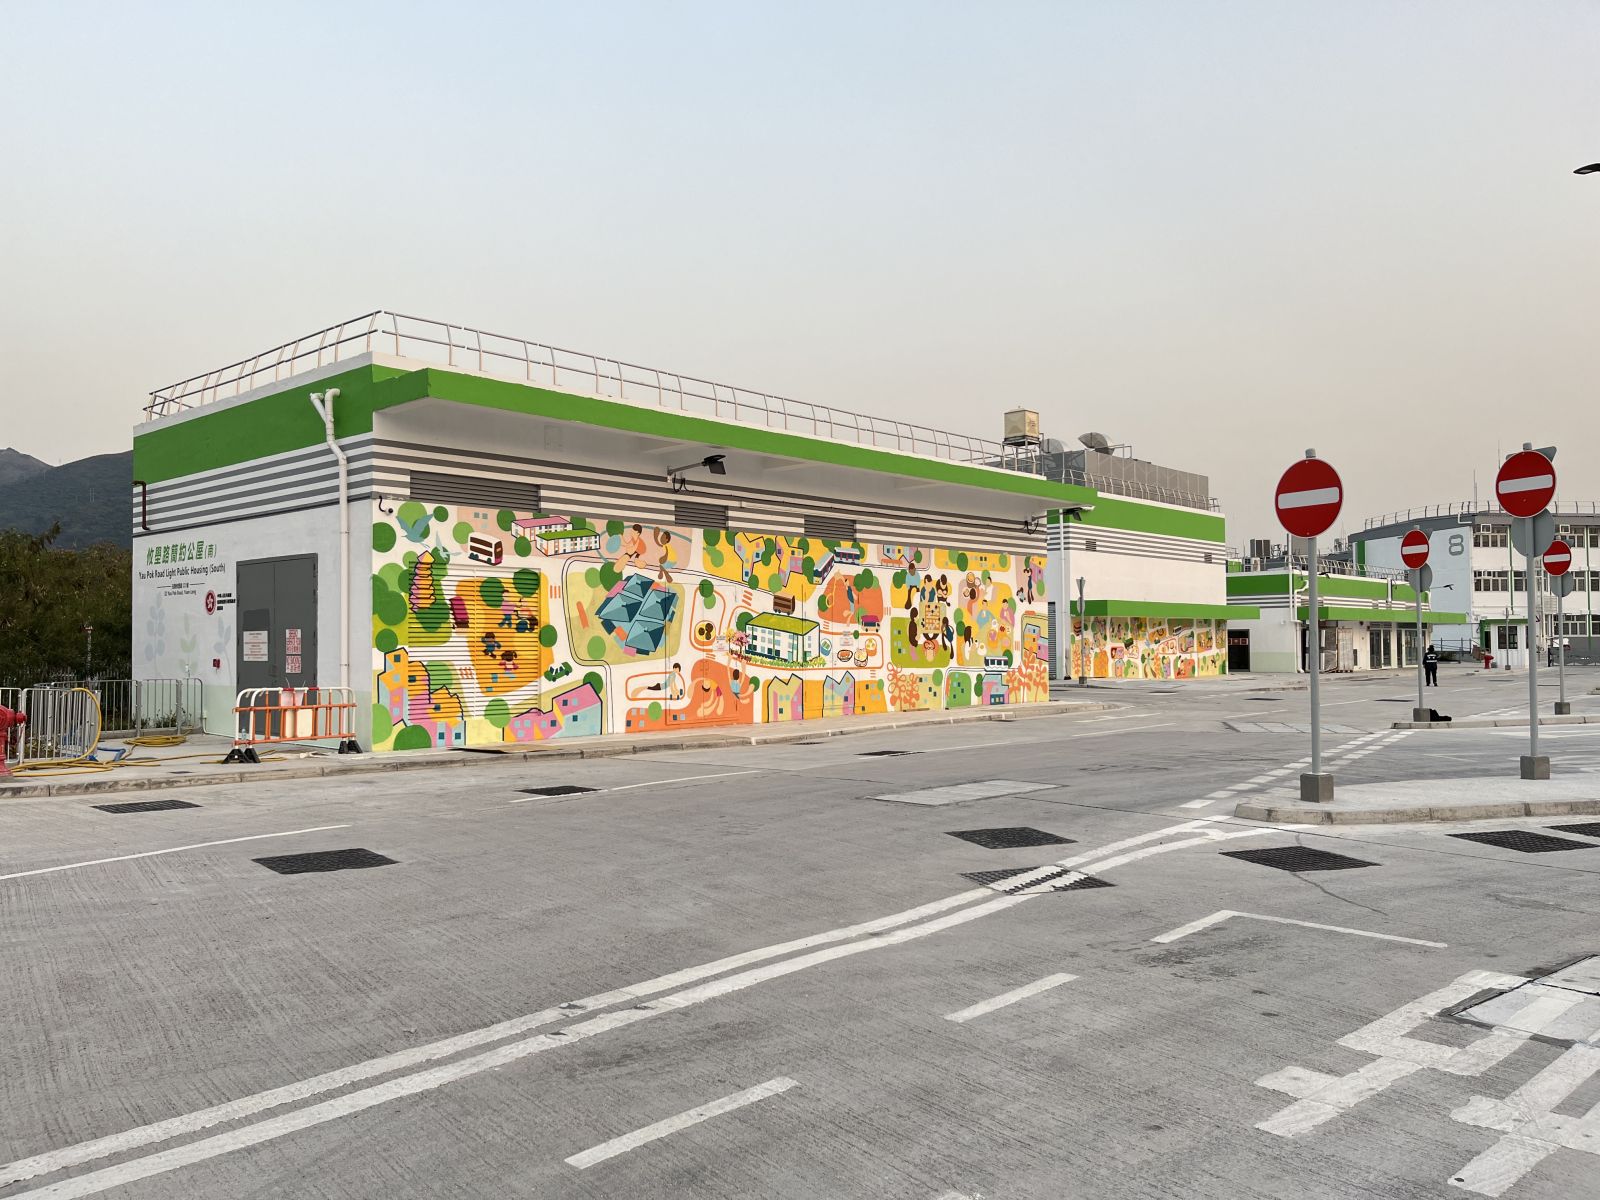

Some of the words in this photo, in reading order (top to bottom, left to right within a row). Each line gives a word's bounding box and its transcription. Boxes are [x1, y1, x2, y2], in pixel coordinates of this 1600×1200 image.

[1448, 534, 1465, 556] 8
[155, 569, 165, 578] Road
[166, 568, 176, 580] Light
[177, 567, 190, 576] Public
[190, 565, 208, 576] Housing
[209, 563, 226, 574] (South)
